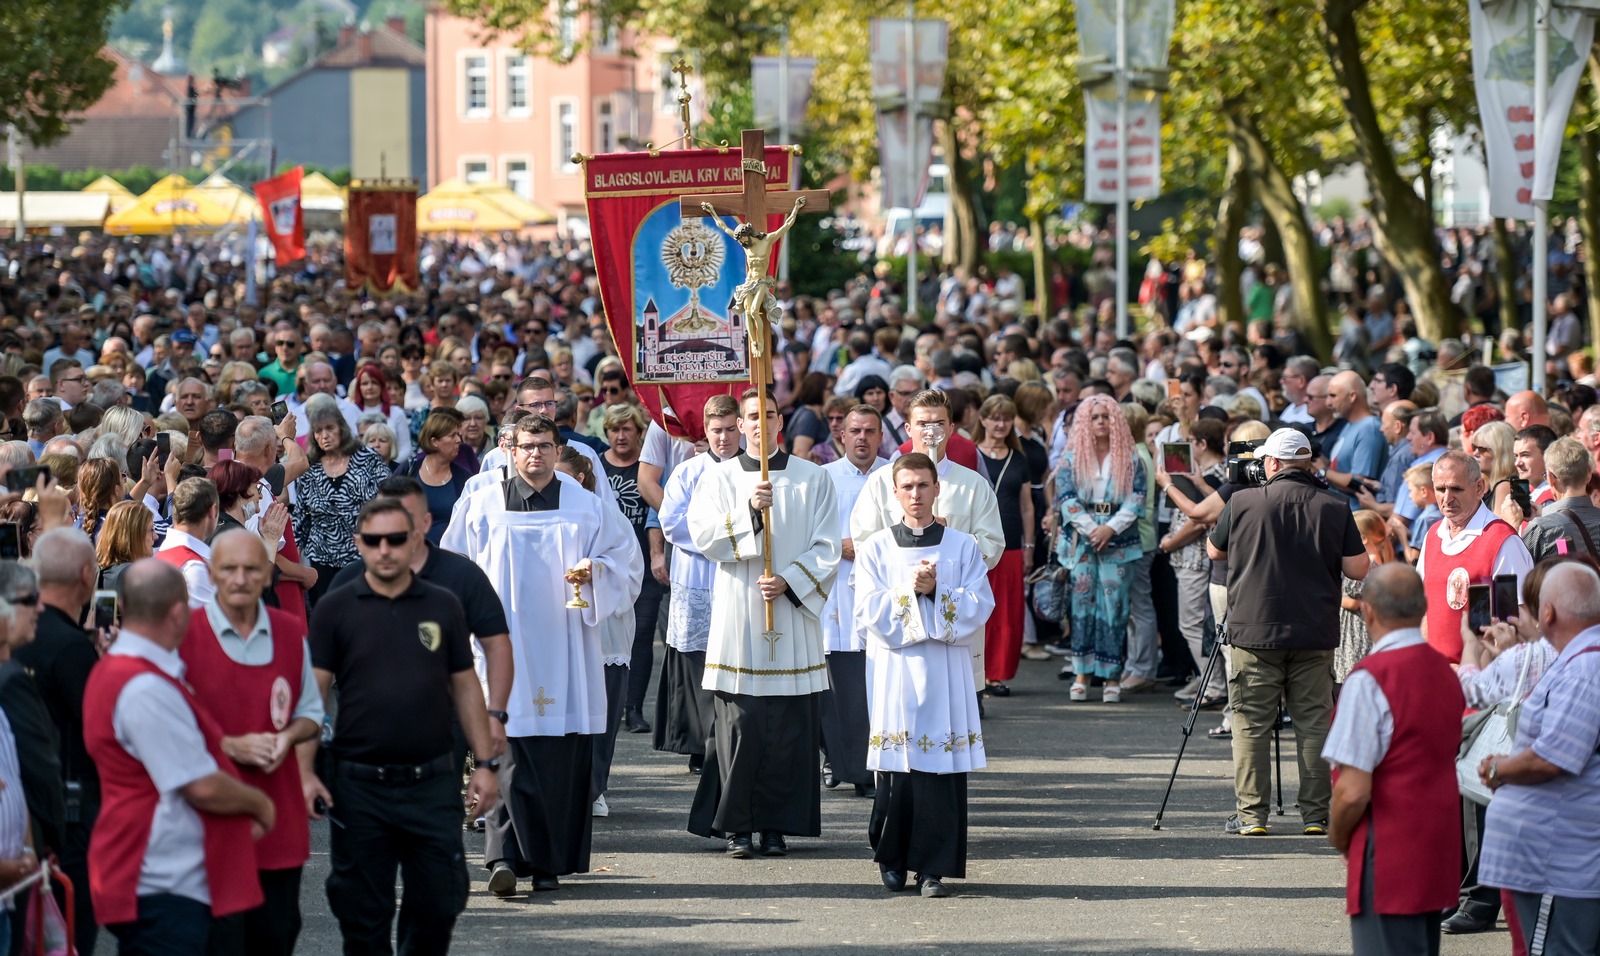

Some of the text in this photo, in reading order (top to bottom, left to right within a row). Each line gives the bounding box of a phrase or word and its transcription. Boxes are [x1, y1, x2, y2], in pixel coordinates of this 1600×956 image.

[594, 165, 781, 188] BLAGOSLOVLJENA KRV KRIVA!
[665, 351, 726, 362] PROŠTENIŠTE
[706, 361, 743, 370] ISUSOVE
[675, 371, 718, 381] LUDBREG
